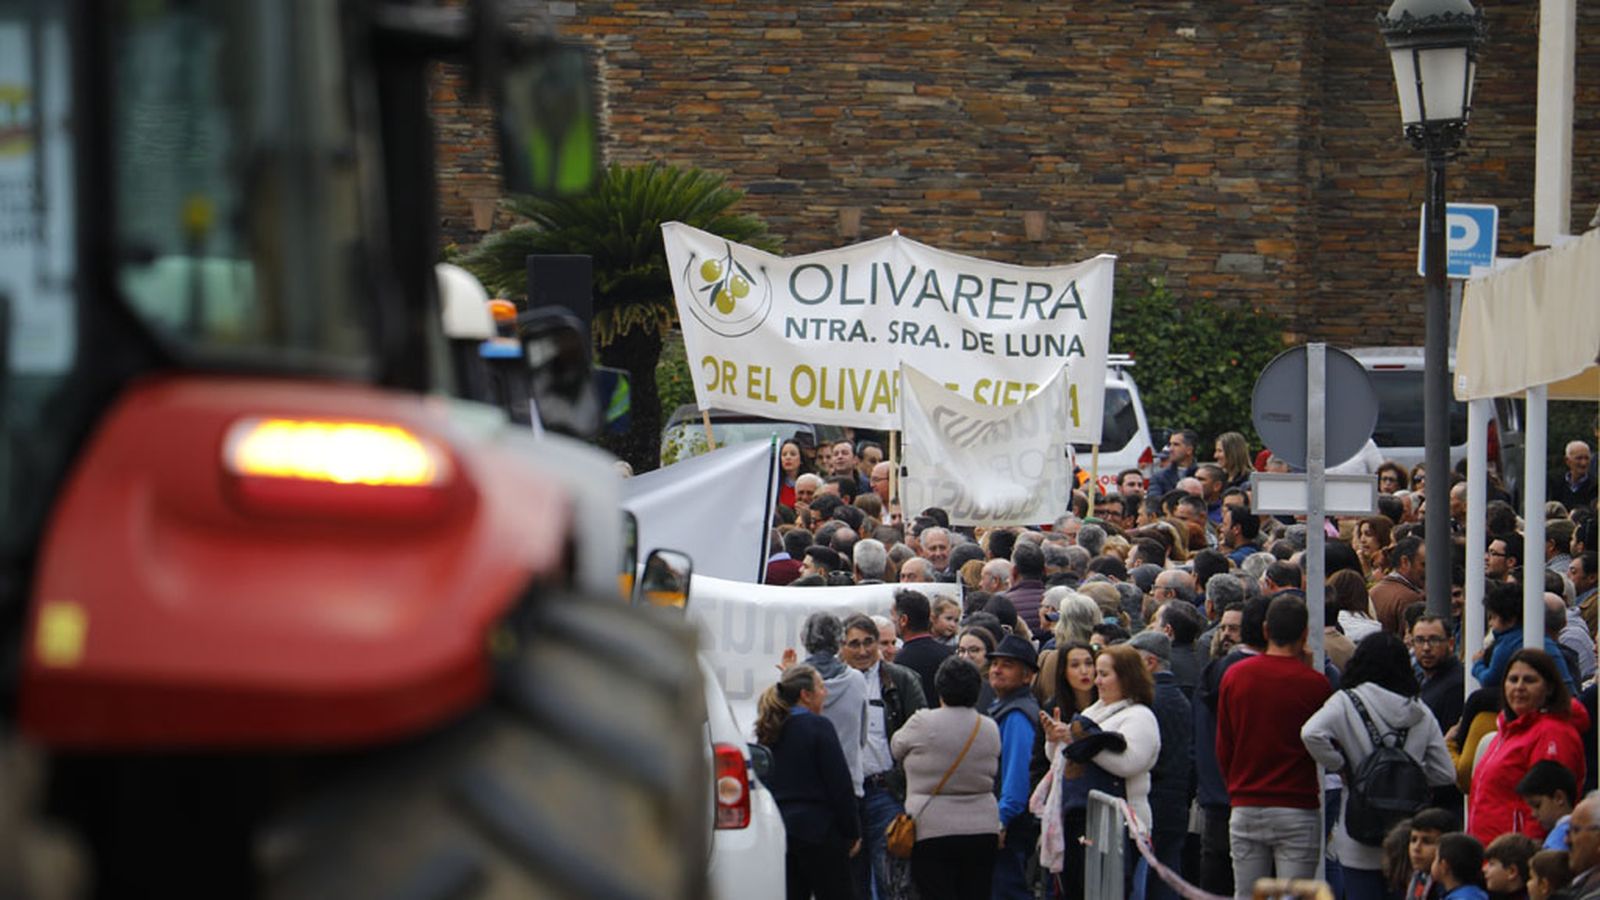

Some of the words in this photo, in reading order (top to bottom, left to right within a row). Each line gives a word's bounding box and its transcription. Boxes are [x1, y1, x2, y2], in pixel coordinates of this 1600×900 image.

[788, 262, 1087, 320] OLIVARERA
[785, 317, 877, 343] NTRA.
[887, 320, 950, 349] SRA.
[961, 329, 995, 355] DE
[1005, 333, 1086, 358] LUNA
[702, 355, 737, 396] OR
[746, 365, 778, 403] EL
